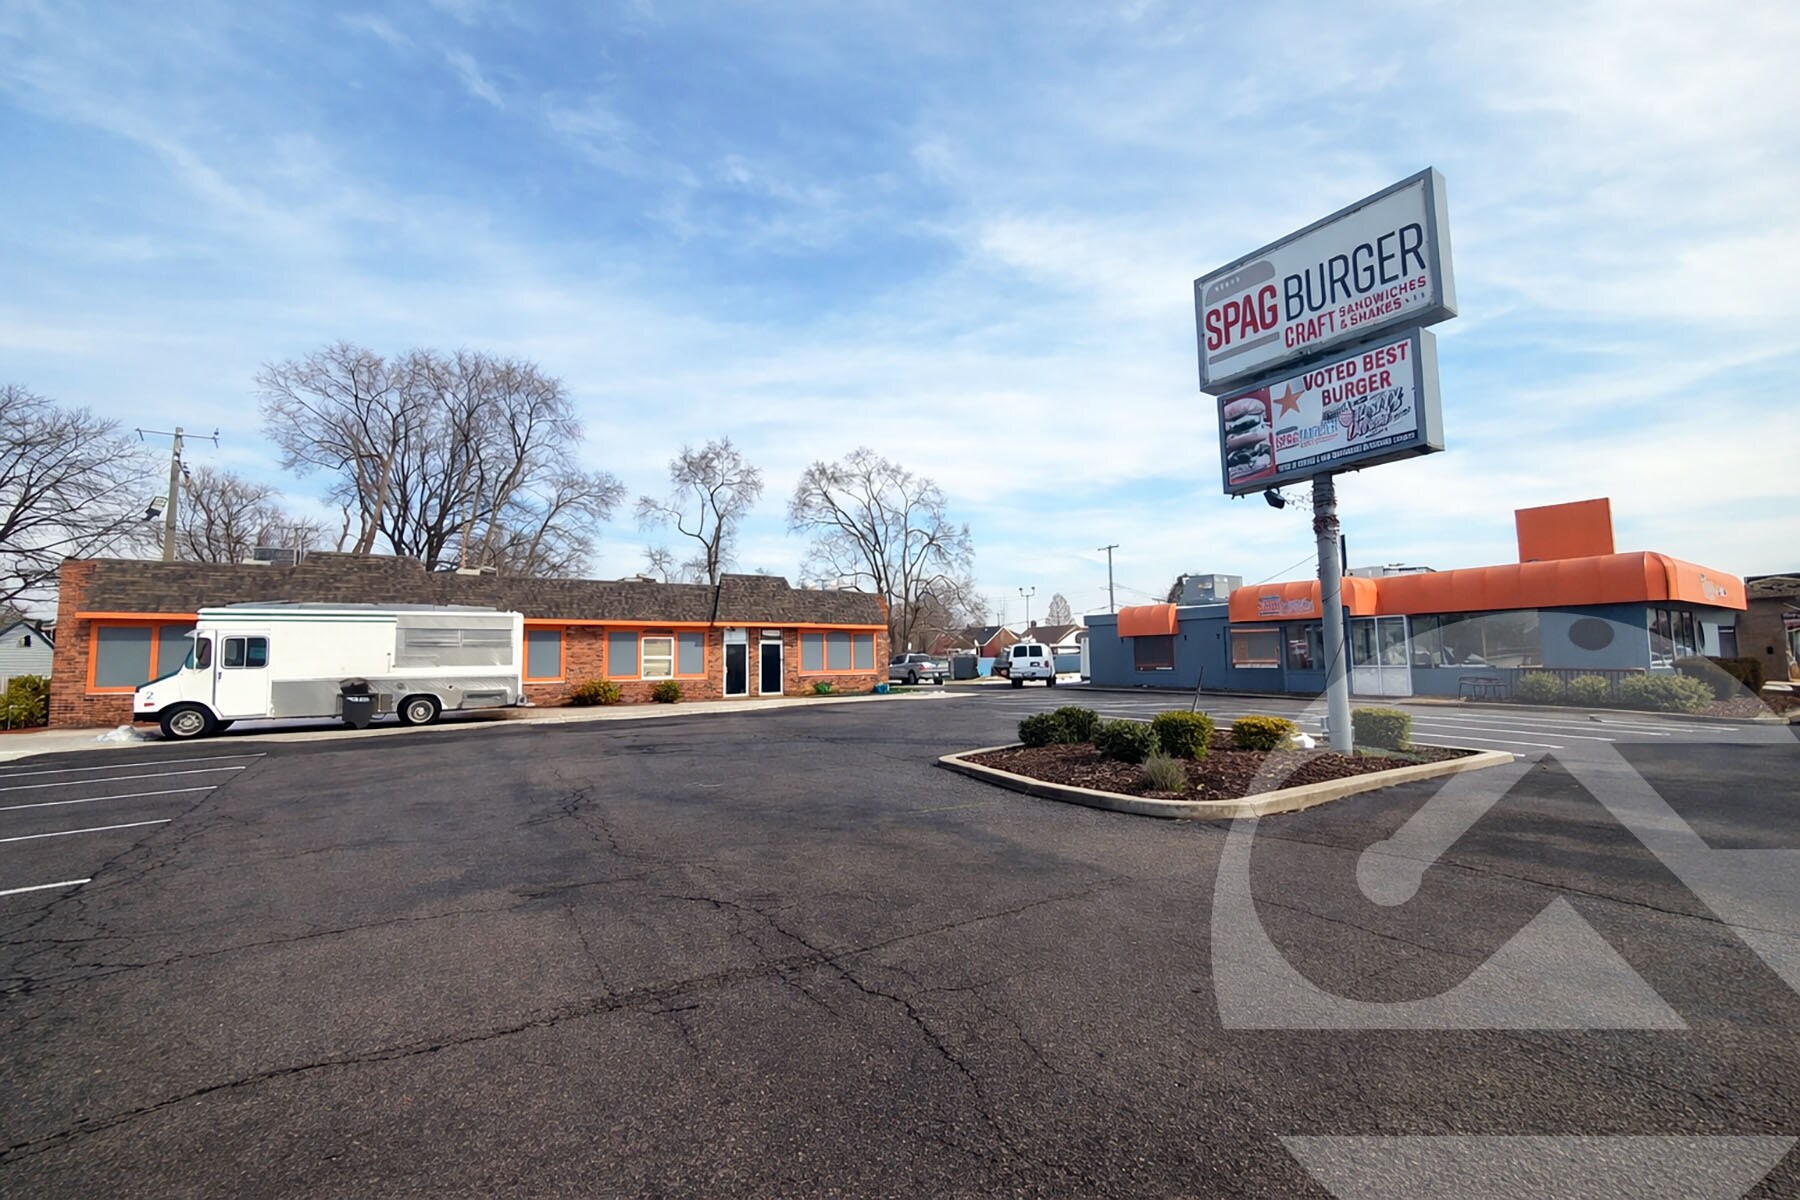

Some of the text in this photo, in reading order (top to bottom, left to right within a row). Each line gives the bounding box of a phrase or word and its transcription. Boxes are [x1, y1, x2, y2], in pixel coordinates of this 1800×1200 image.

[1205, 222, 1426, 351] SPAG BURGER
[1339, 275, 1426, 318] SANDWICHES
[1284, 310, 1336, 348] CRAFT
[1350, 297, 1402, 326] SHAKES
[1303, 341, 1409, 391] VOTED BEST
[1322, 370, 1393, 407] BURGER
